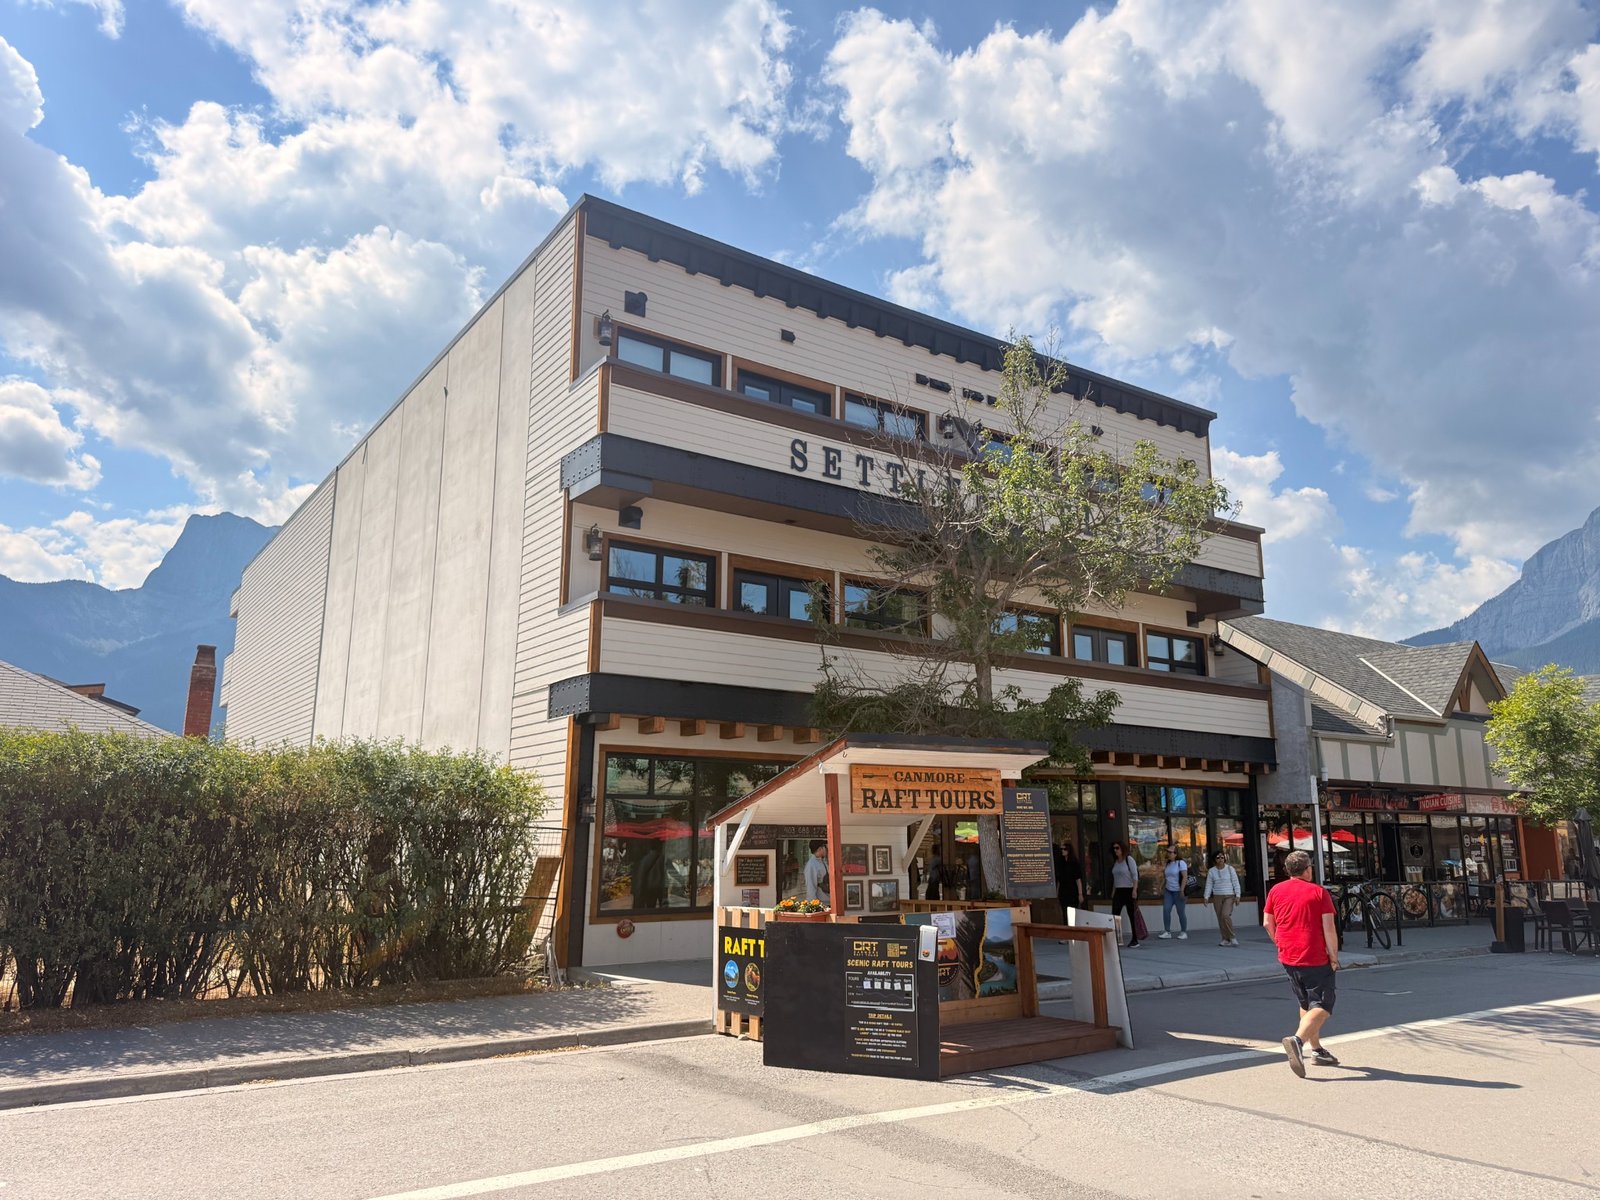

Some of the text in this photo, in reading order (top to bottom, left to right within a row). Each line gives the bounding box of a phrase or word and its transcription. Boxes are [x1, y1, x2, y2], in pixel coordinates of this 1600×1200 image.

[893, 771, 965, 784] CANMORE
[861, 788, 996, 810] RAFT TOURS
[1419, 797, 1440, 809] INDIAN
[724, 936, 756, 957] RAFT
[853, 941, 879, 951] CRT
[847, 959, 914, 969] SCENIC RAFT TOURS
